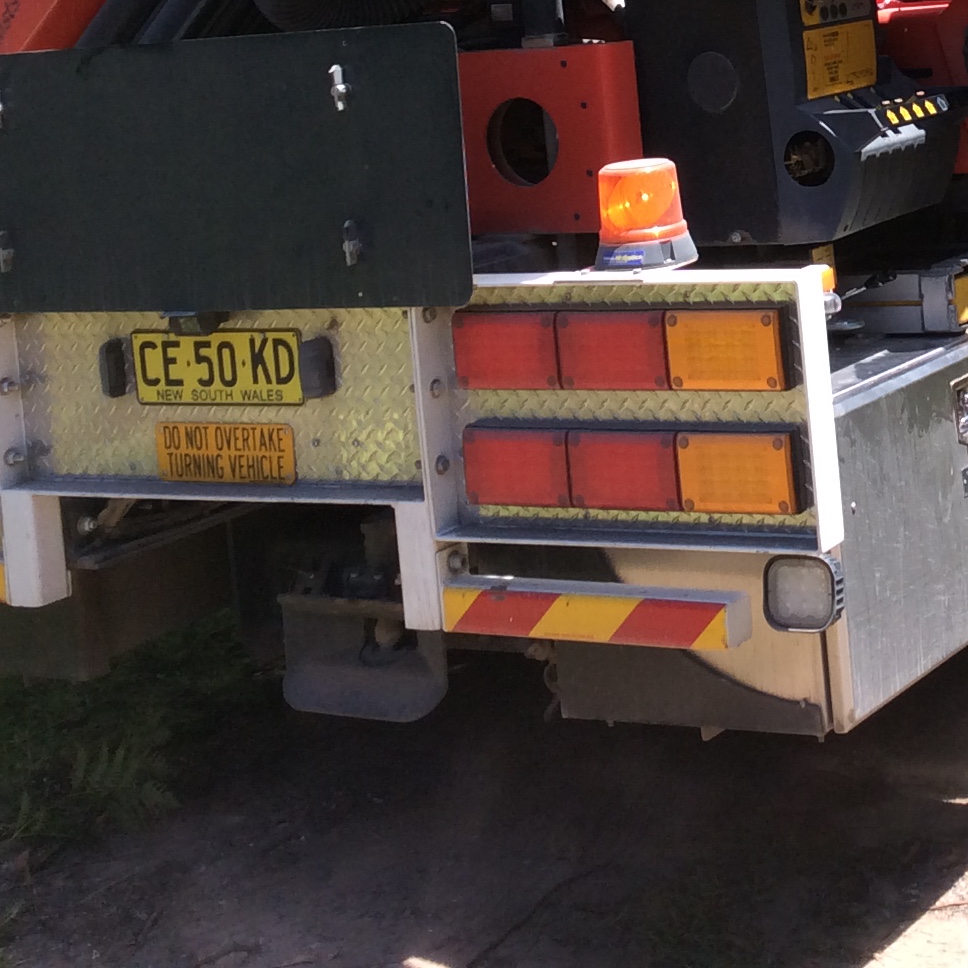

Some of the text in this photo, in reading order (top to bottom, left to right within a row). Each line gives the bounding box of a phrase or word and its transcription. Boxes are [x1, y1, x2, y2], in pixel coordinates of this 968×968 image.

[156, 389, 284, 402] NEW SOUTH WALES
[162, 425, 286, 453] DO NOT OVERTAKE
[166, 452, 286, 481] TURNING VEHICLE
